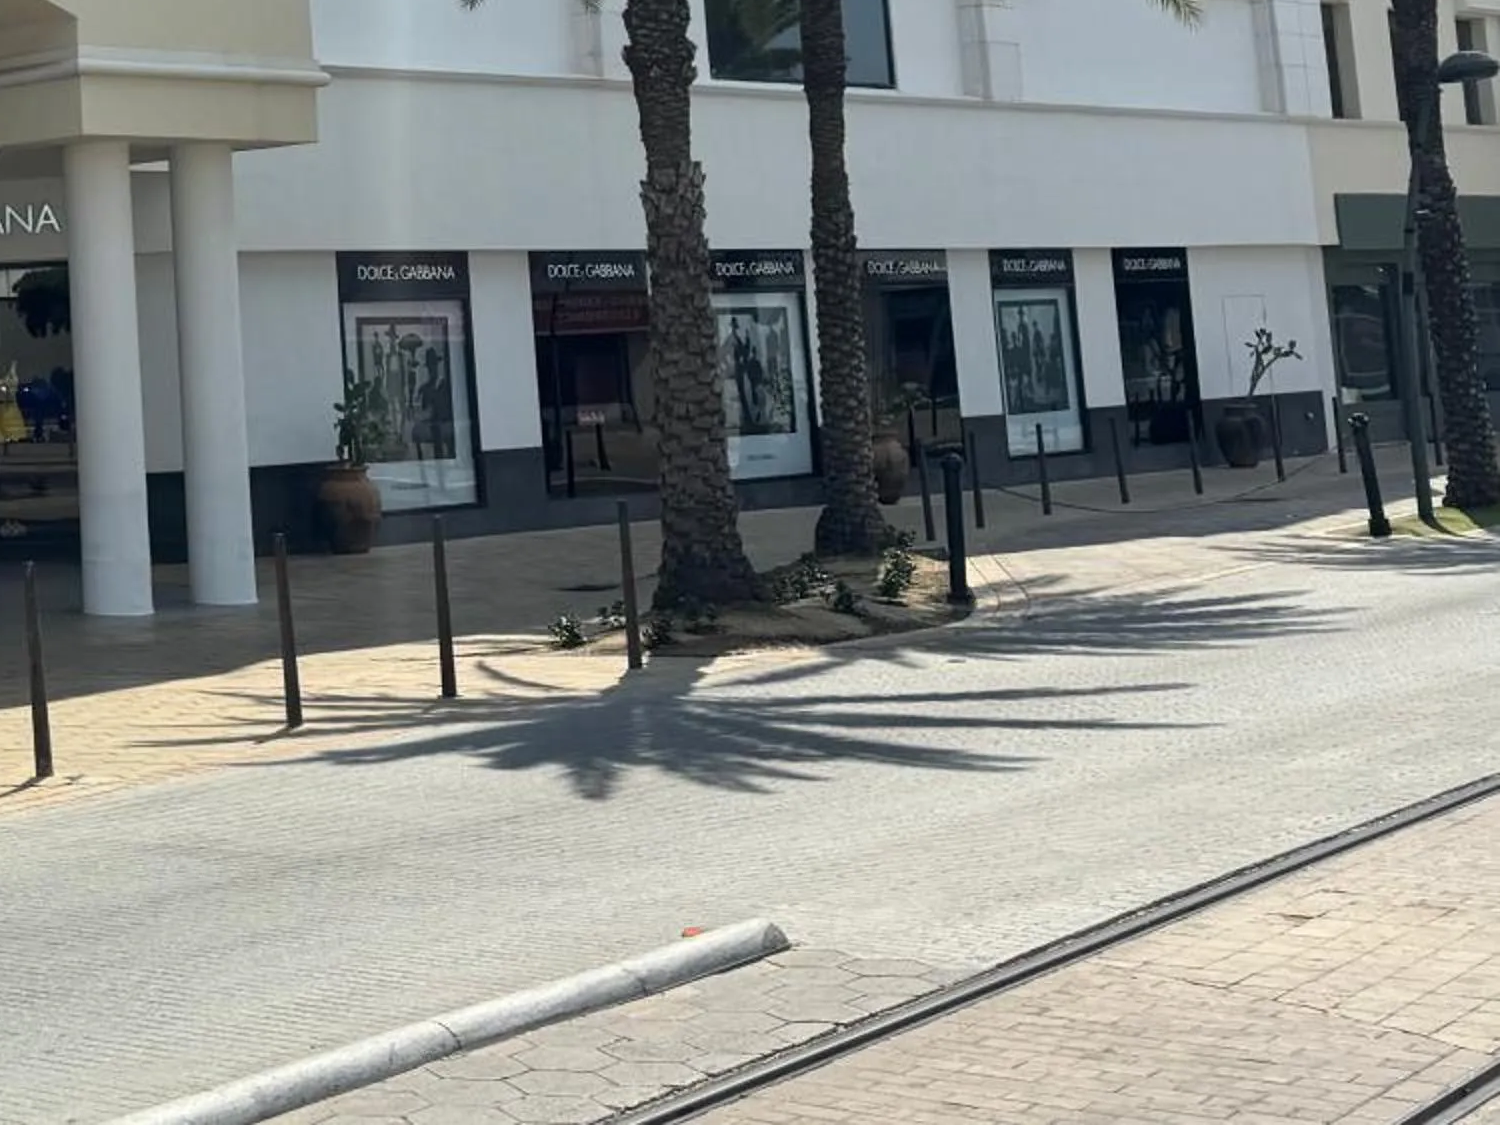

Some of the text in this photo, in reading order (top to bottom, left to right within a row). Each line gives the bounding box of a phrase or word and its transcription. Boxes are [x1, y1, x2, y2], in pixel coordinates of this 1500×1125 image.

[357, 265, 395, 281] DOLCE
[400, 264, 456, 281] GABBANA
[547, 263, 635, 278] DOLCE GABBANA
